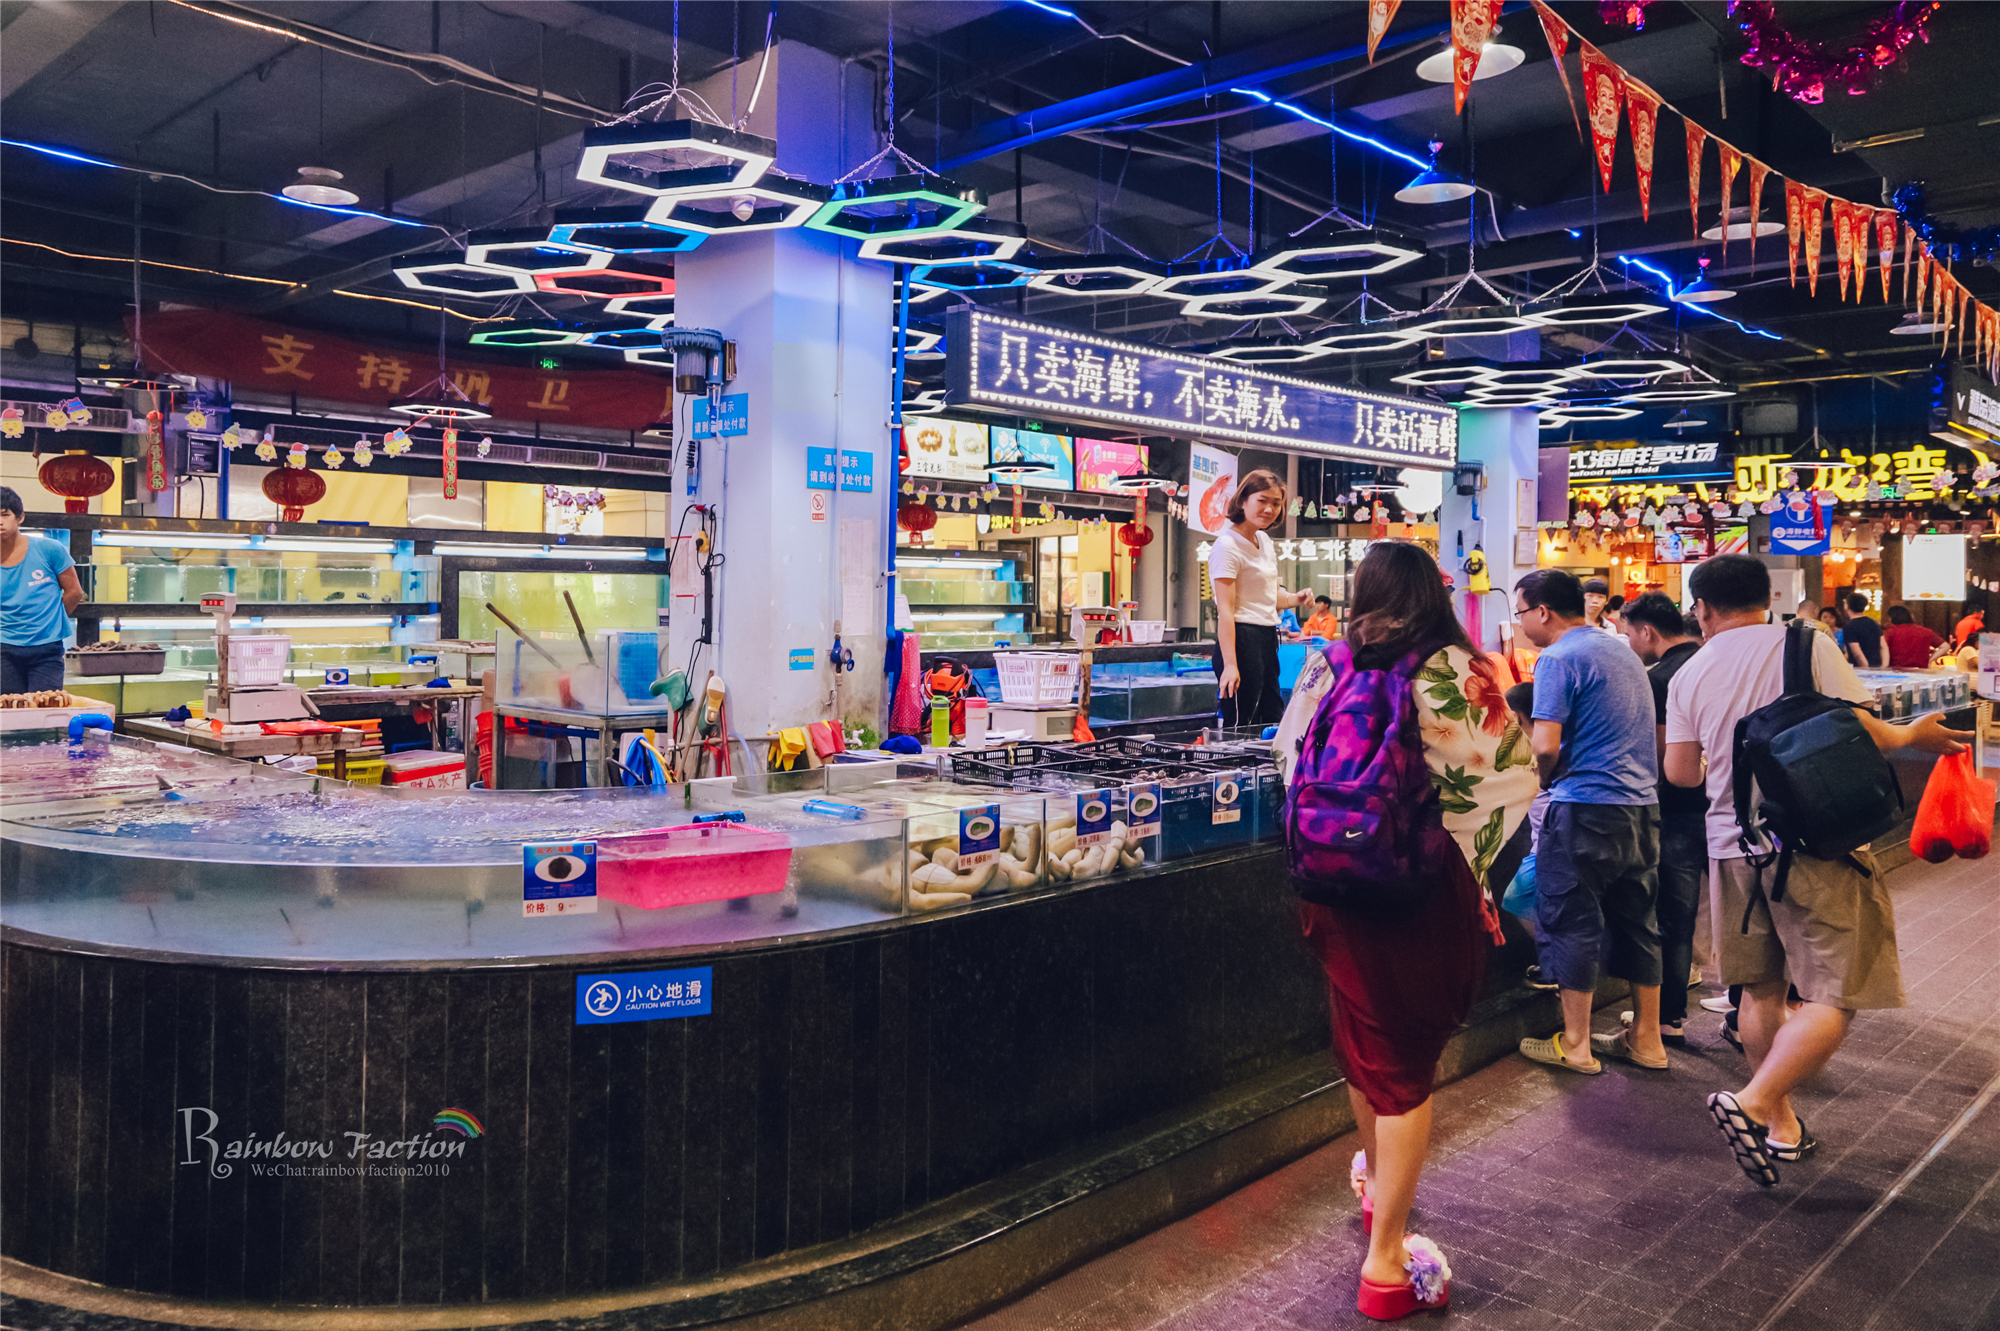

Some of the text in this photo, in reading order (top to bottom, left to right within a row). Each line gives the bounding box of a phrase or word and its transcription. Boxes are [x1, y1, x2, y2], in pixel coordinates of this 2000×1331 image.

[557, 902, 564, 912] 9
[626, 980, 702, 1003] 小心地滑
[625, 998, 702, 1011] CAUTION WET FLOOR
